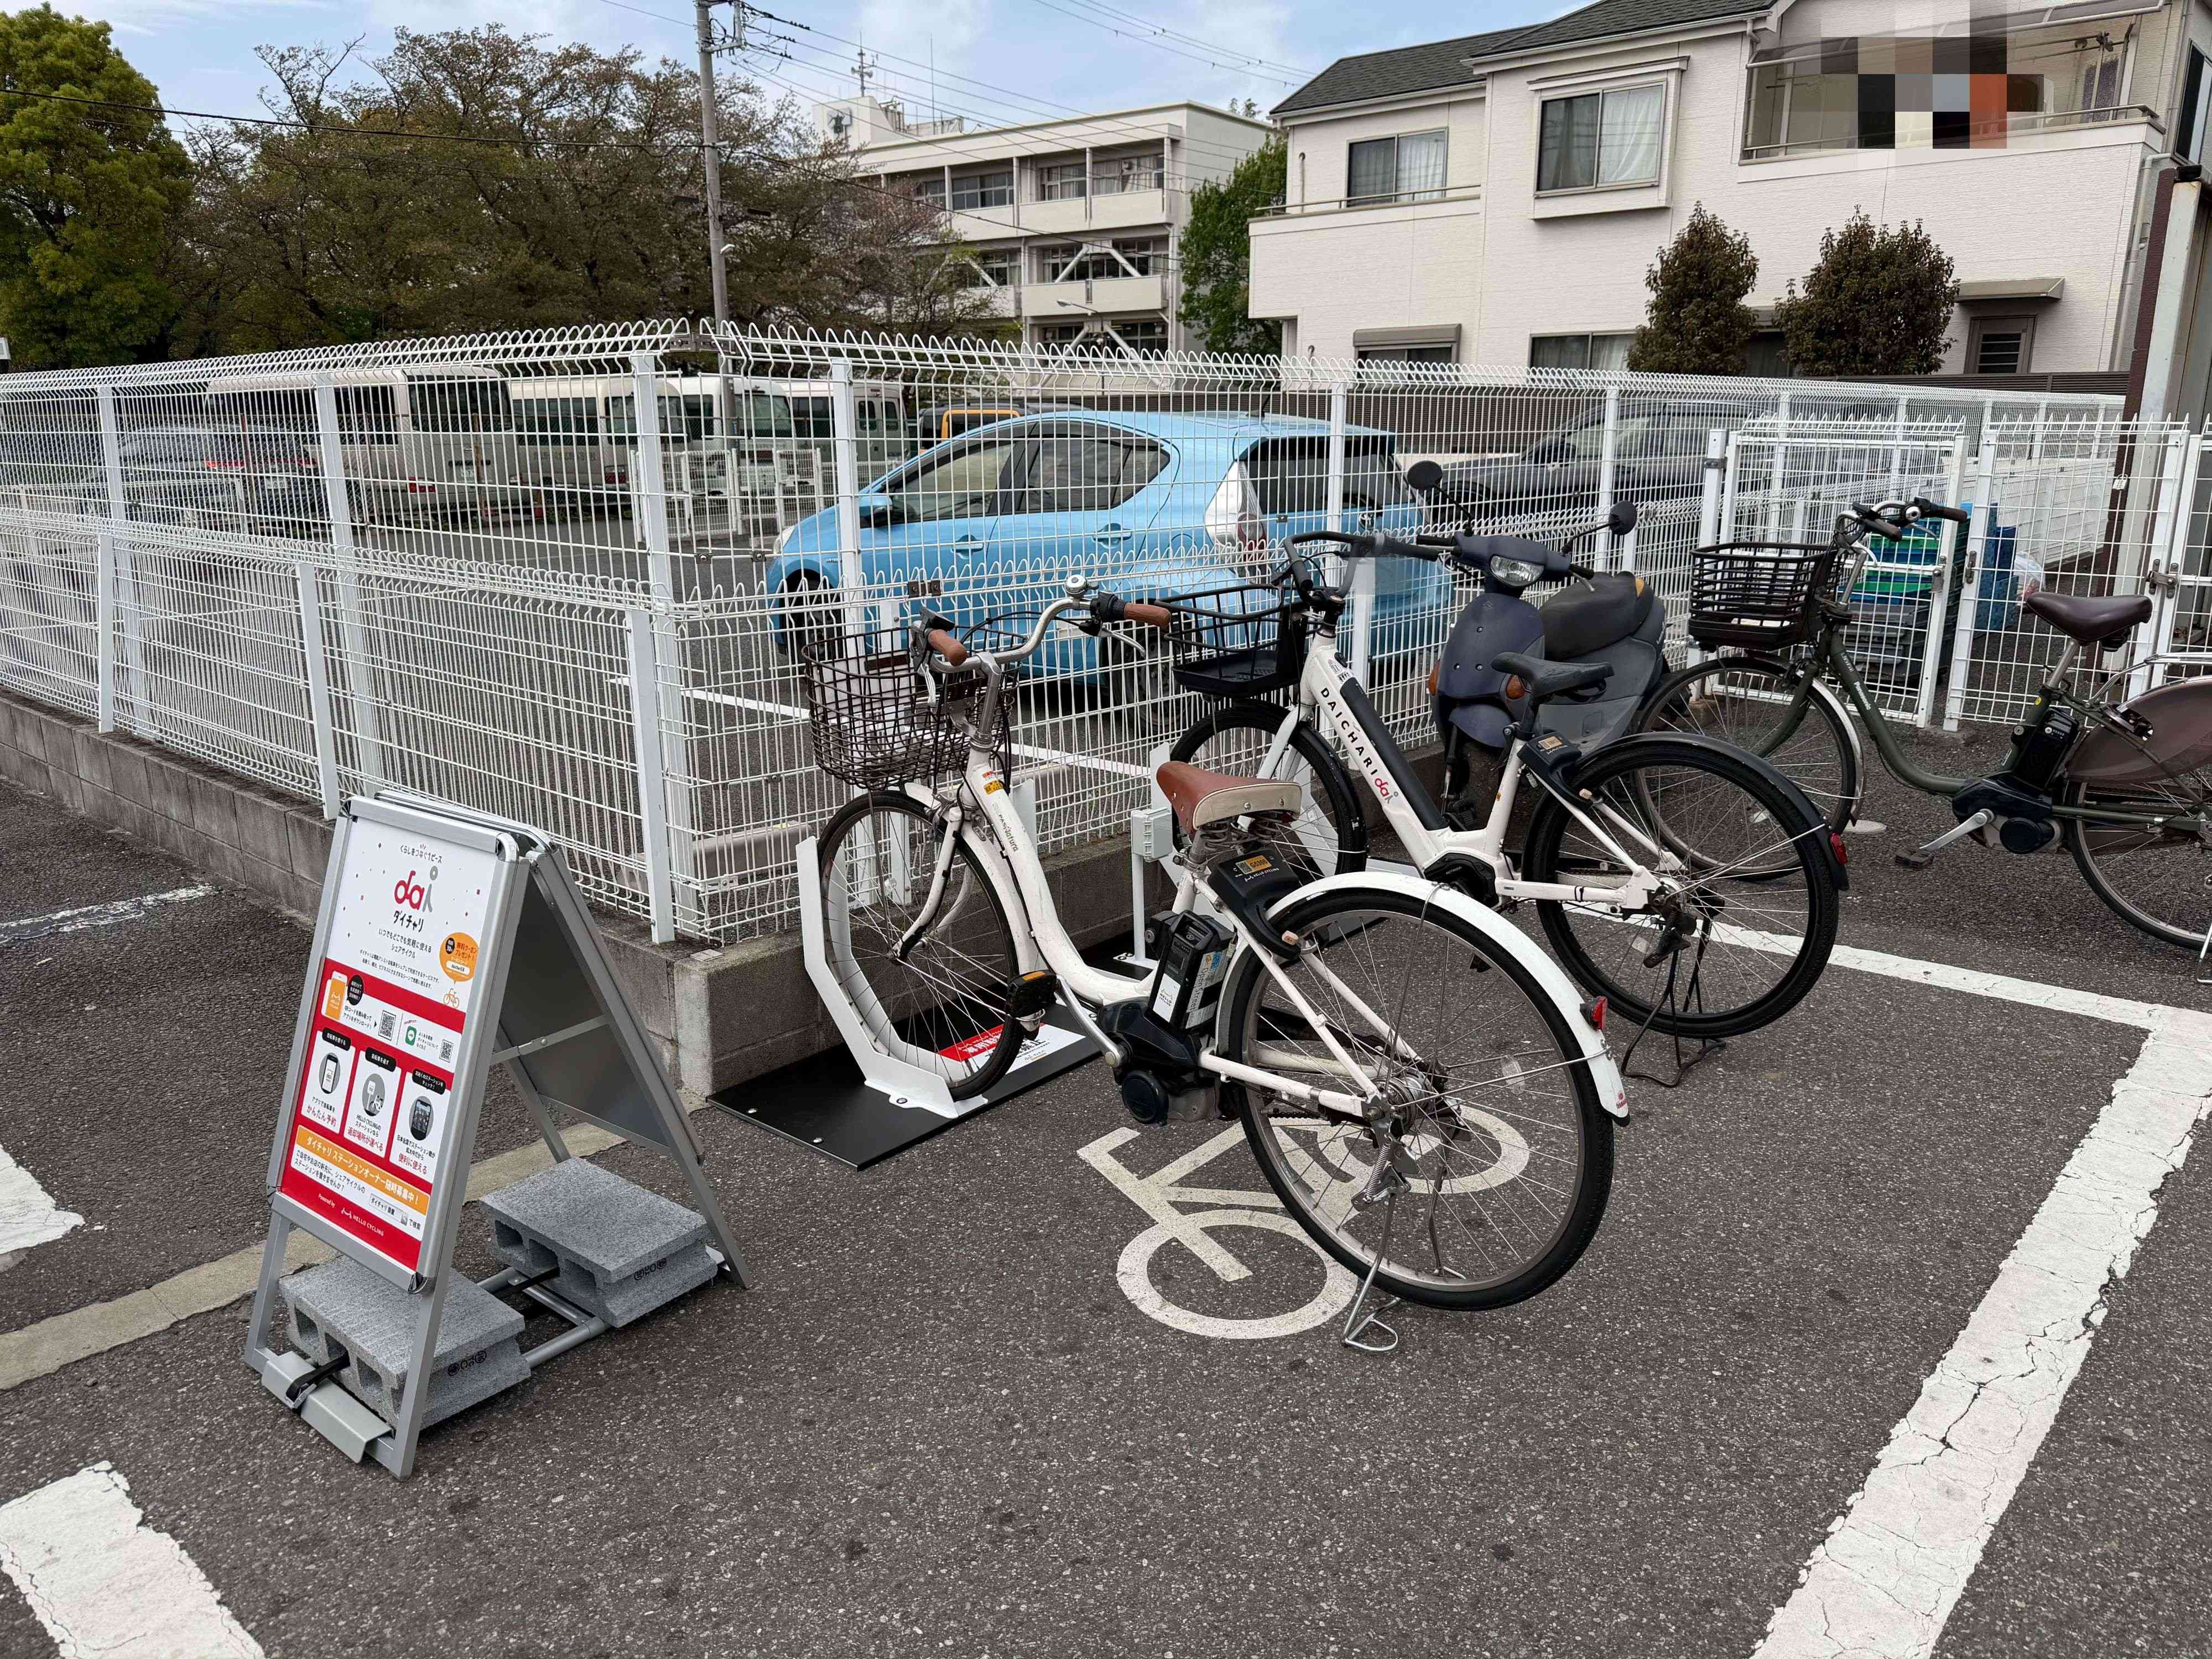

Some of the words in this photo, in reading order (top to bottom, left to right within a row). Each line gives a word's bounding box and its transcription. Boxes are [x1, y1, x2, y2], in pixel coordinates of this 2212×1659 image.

[1854, 681, 1871, 711] Panasonic
[1320, 687, 1378, 776] DAICHARI
[1004, 827, 1018, 852] Natura
[394, 865, 439, 912] dai
[393, 910, 424, 932] ダイチャリ
[378, 928, 431, 953] いつでもどこでも気軽に使える
[391, 944, 415, 958] シェアサイクル
[306, 1104, 337, 1127] かんたん予約
[306, 1136, 332, 1156] ダイチャリ
[347, 1126, 383, 1152] 返却場所が選べる
[398, 1153, 428, 1175] 便利に使える
[352, 1214, 366, 1226] HELLO
[366, 1223, 384, 1237] CYCLING
